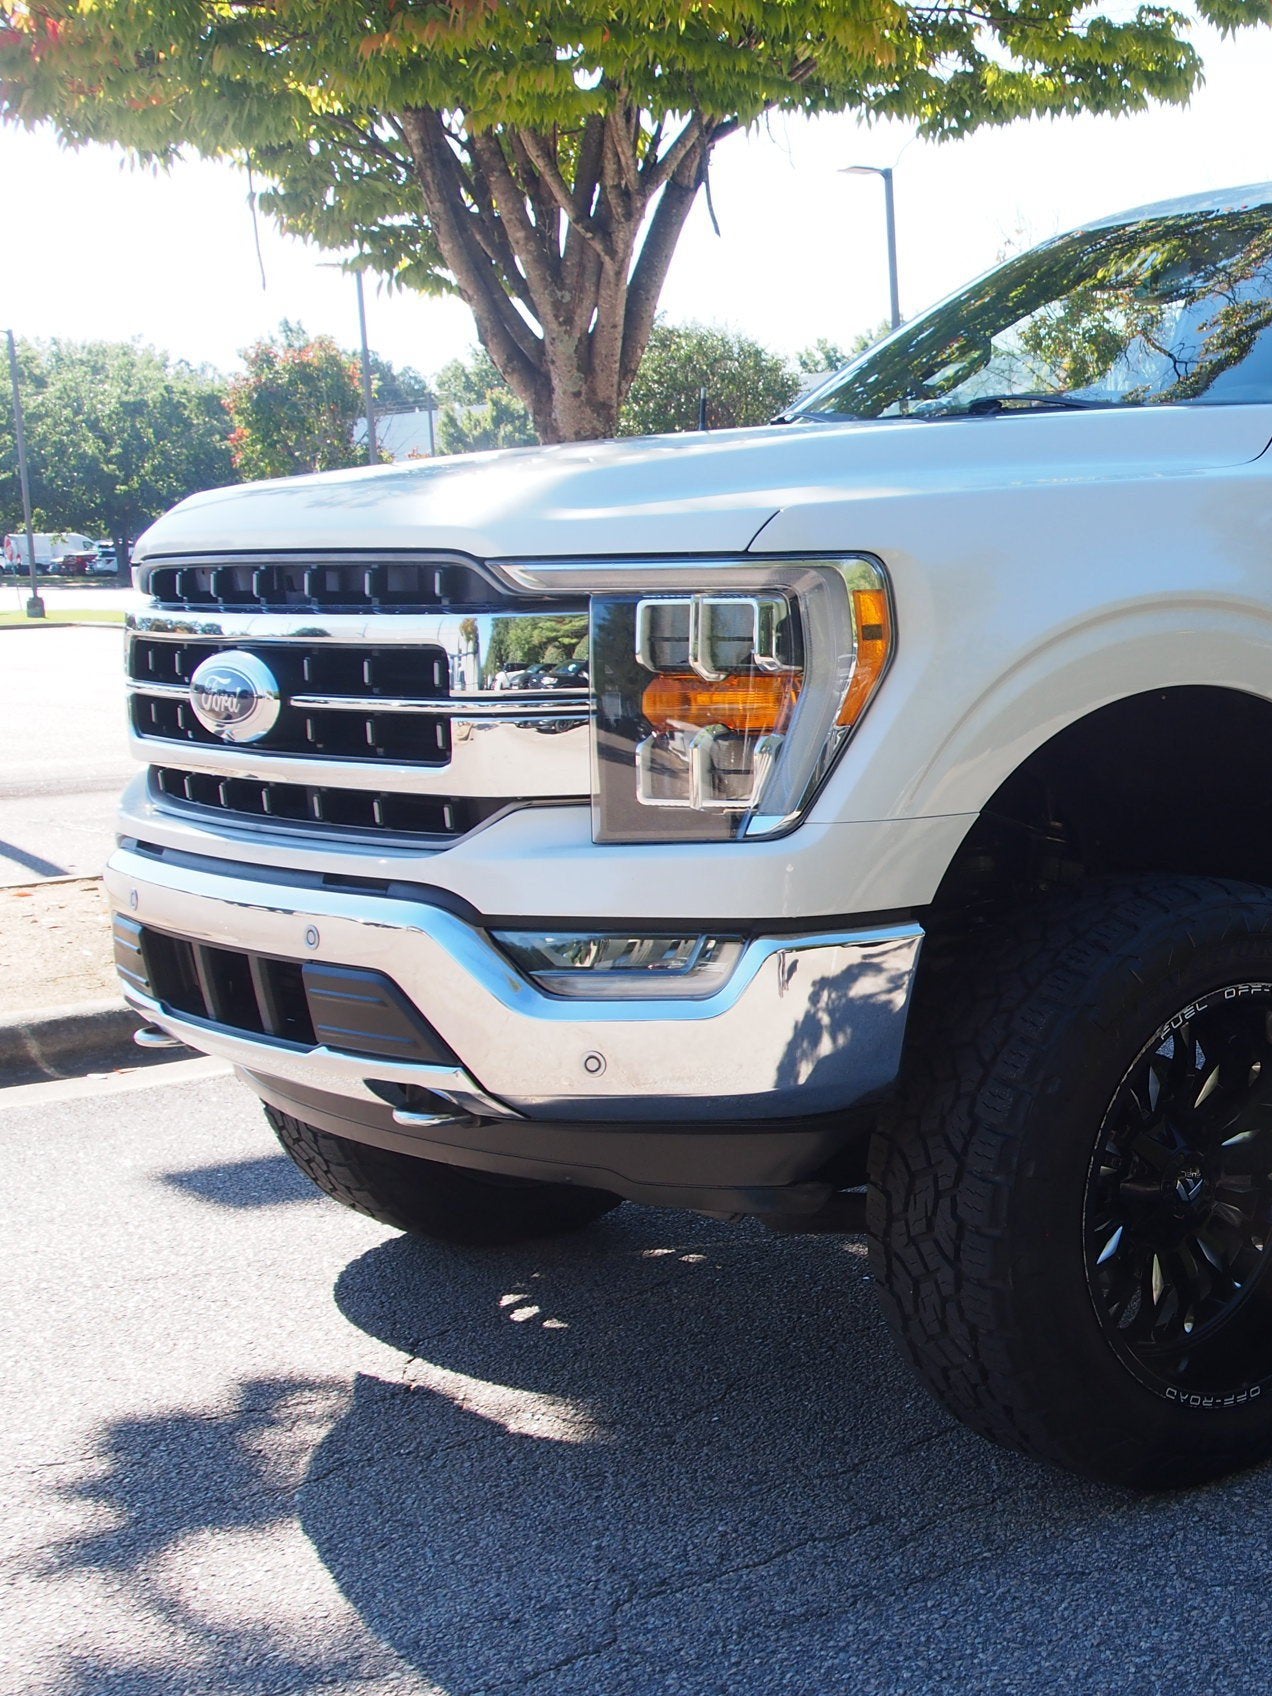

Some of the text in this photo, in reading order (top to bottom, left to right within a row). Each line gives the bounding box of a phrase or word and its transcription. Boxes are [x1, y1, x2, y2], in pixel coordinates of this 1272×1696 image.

[201, 675, 241, 713] Ford
[1160, 1002, 1208, 1041] FUEL
[1165, 1386, 1261, 1406] OFF-ROAD
